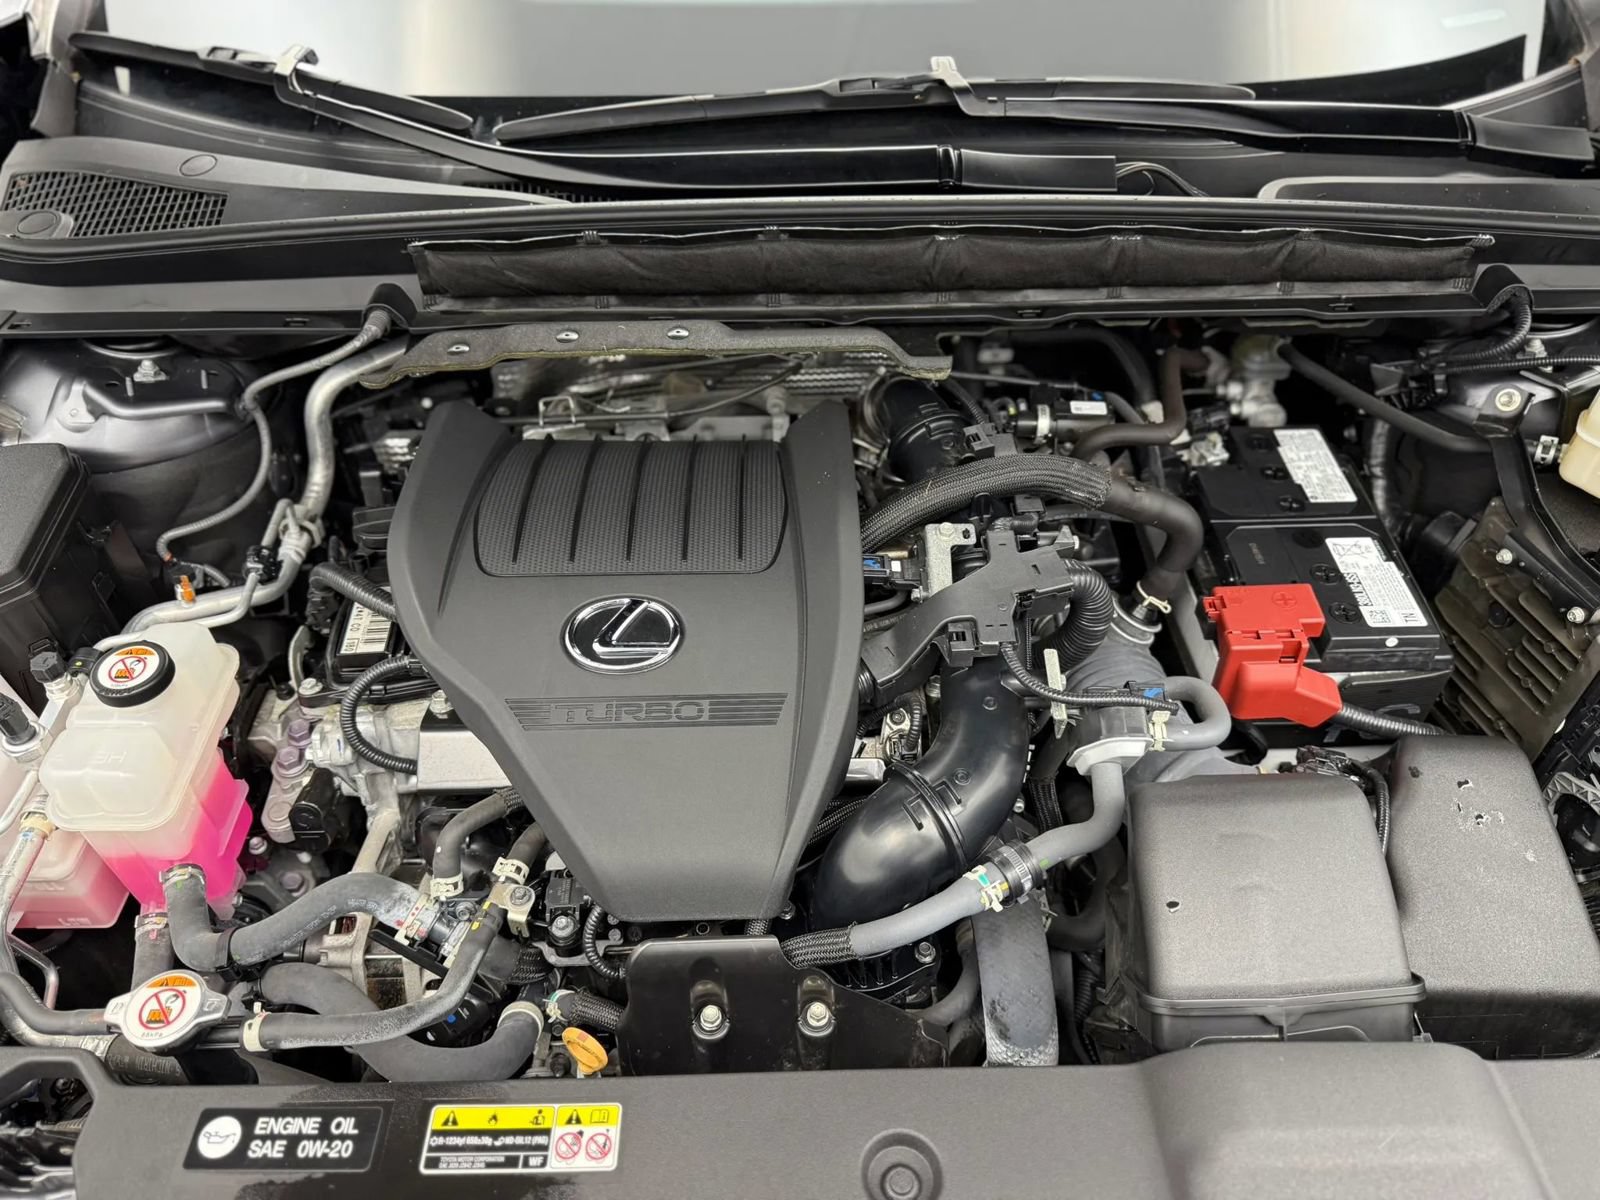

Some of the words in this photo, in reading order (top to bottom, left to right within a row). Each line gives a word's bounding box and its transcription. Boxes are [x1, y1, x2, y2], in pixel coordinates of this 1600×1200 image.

[554, 701, 705, 723] TURBO
[254, 1116, 322, 1135] ENGINE
[330, 1116, 359, 1135] OIL
[247, 1139, 287, 1159] SAE
[296, 1139, 354, 1159] 0W-20
[528, 1156, 544, 1167] WF
